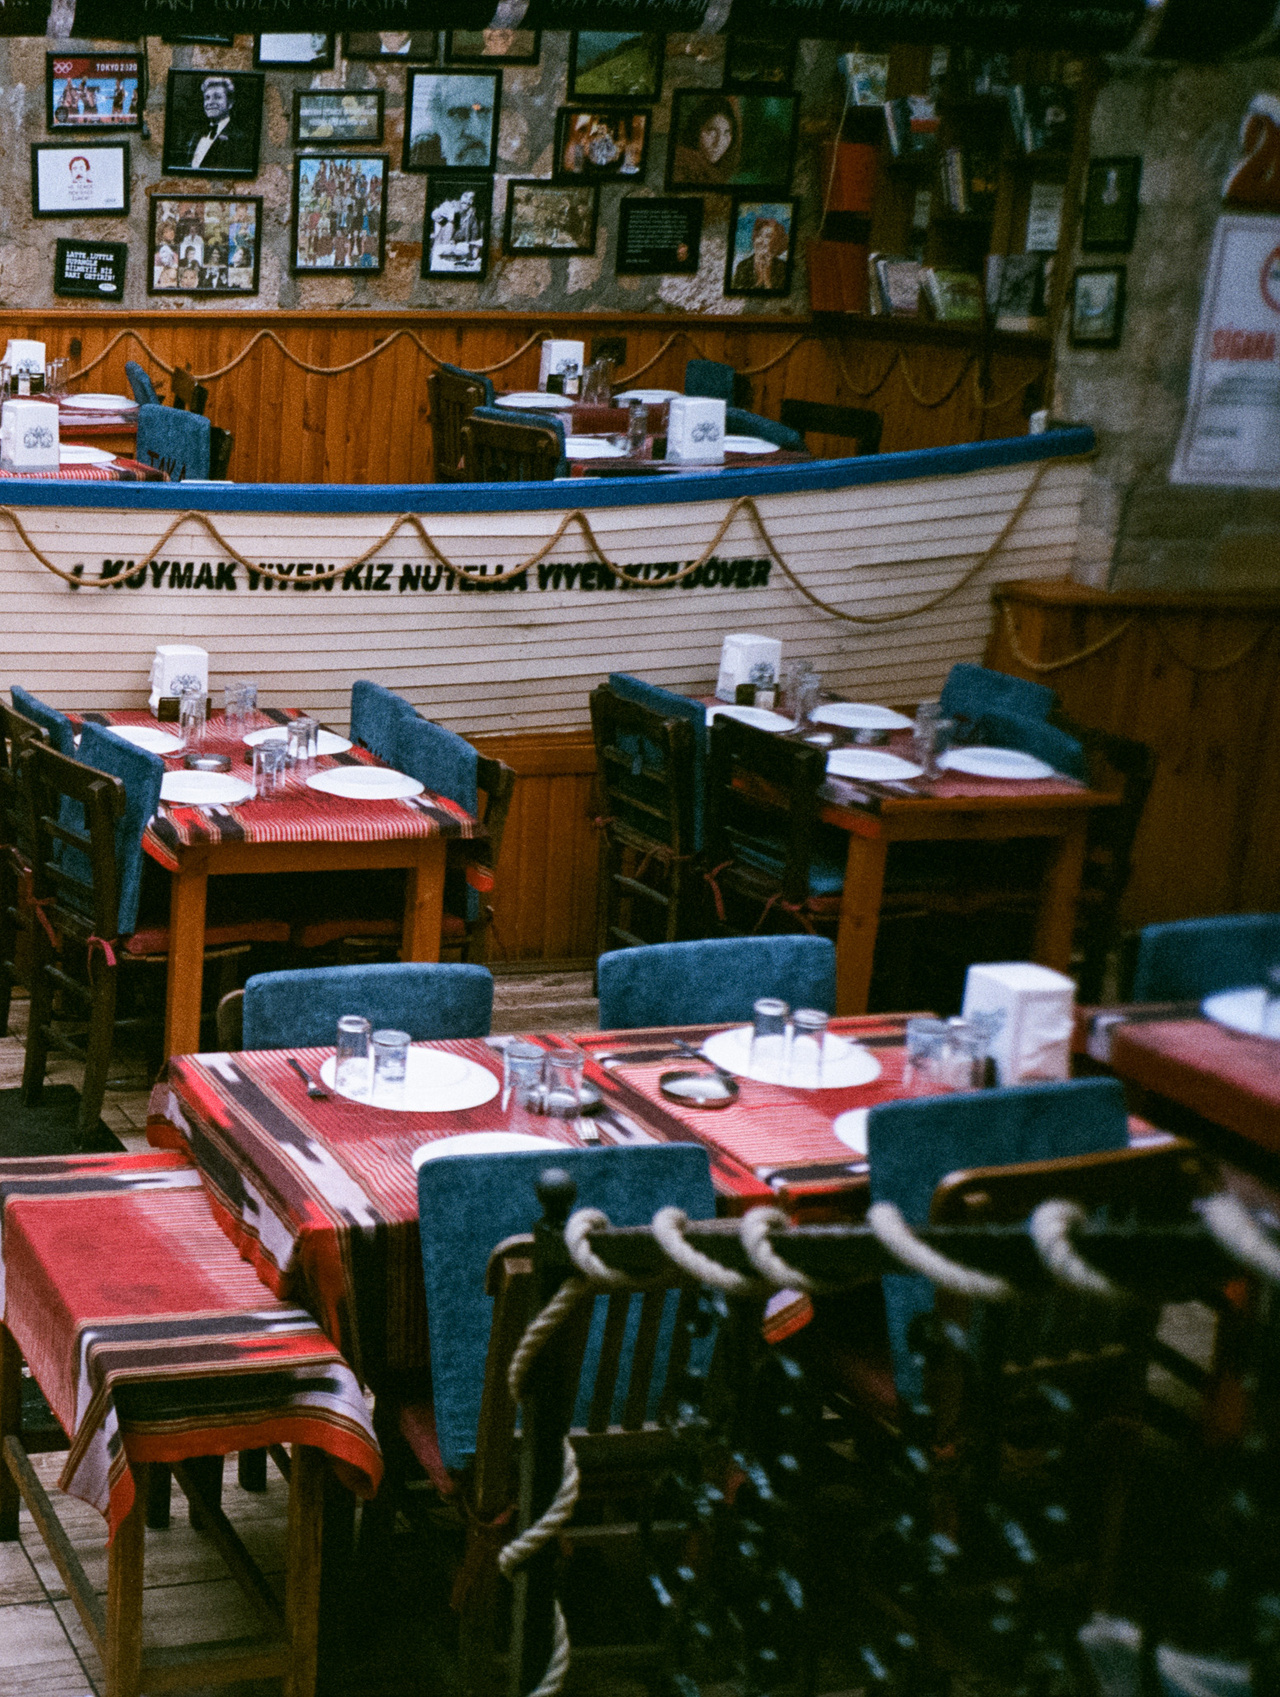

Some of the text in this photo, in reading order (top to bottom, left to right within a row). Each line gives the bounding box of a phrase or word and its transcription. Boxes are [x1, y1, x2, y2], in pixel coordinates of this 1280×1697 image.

[96, 62, 119, 72] TOKYO
[99, 559, 238, 591] KUYMAK
[342, 562, 392, 591] KIZ
[398, 564, 526, 593] NUTELLA
[682, 556, 772, 590] DÖVER
